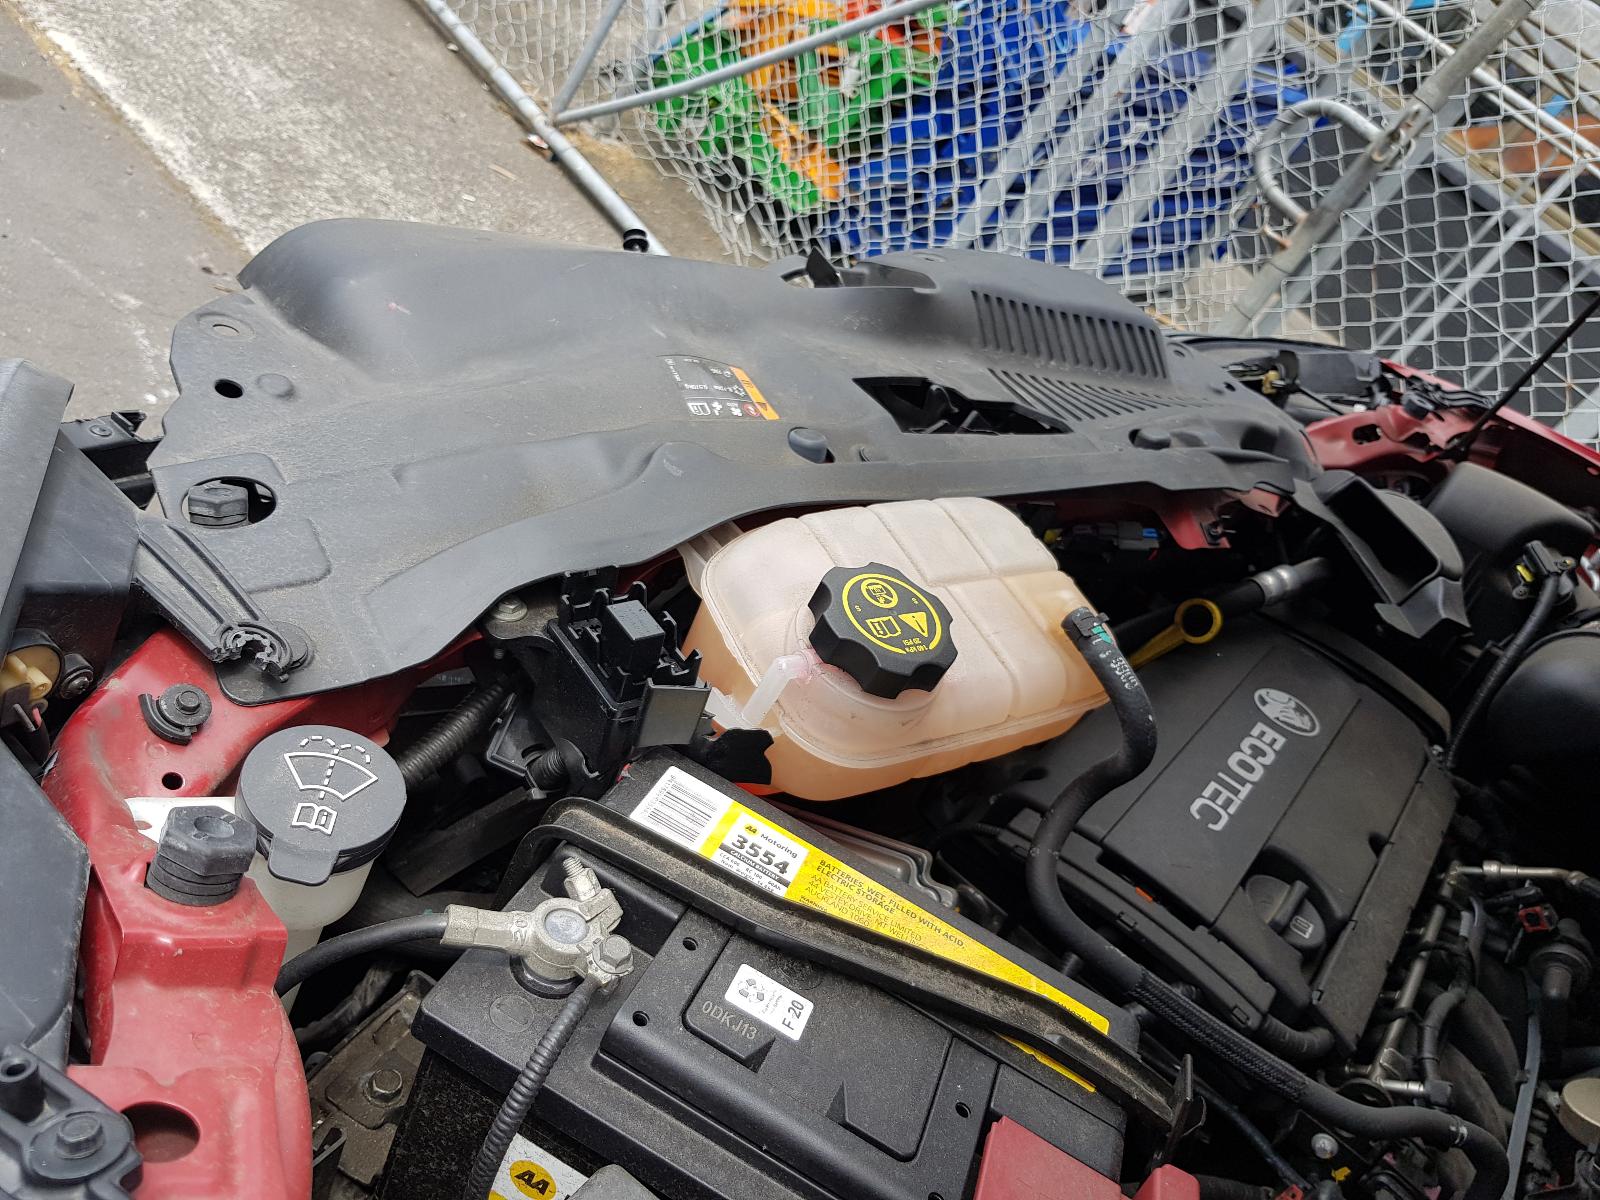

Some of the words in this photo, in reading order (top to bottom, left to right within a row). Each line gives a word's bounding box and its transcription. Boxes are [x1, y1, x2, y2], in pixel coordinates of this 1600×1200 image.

[1189, 721, 1288, 831] ECOTEC
[731, 834, 790, 875] 3554
[760, 833, 798, 859] Motoring
[730, 850, 756, 867] CALCIUM
[755, 863, 780, 881] BATTERY
[805, 885, 849, 915] AUCKLAND
[811, 874, 822, 884] AA
[823, 879, 860, 905] BATTERY
[858, 900, 889, 922] SERVICE
[890, 917, 922, 942] LIMITED
[816, 866, 854, 891] ELECTRIC
[855, 888, 896, 915] STORAGE
[819, 859, 864, 889] BATTERIES,
[889, 897, 917, 919] FILLED
[919, 915, 942, 934] WITH
[820, 885, 850, 908] VESTEY
[874, 918, 888, 930] MT
[781, 1017, 794, 1031] F
[787, 999, 805, 1019] 20
[513, 1169, 551, 1196] AA
